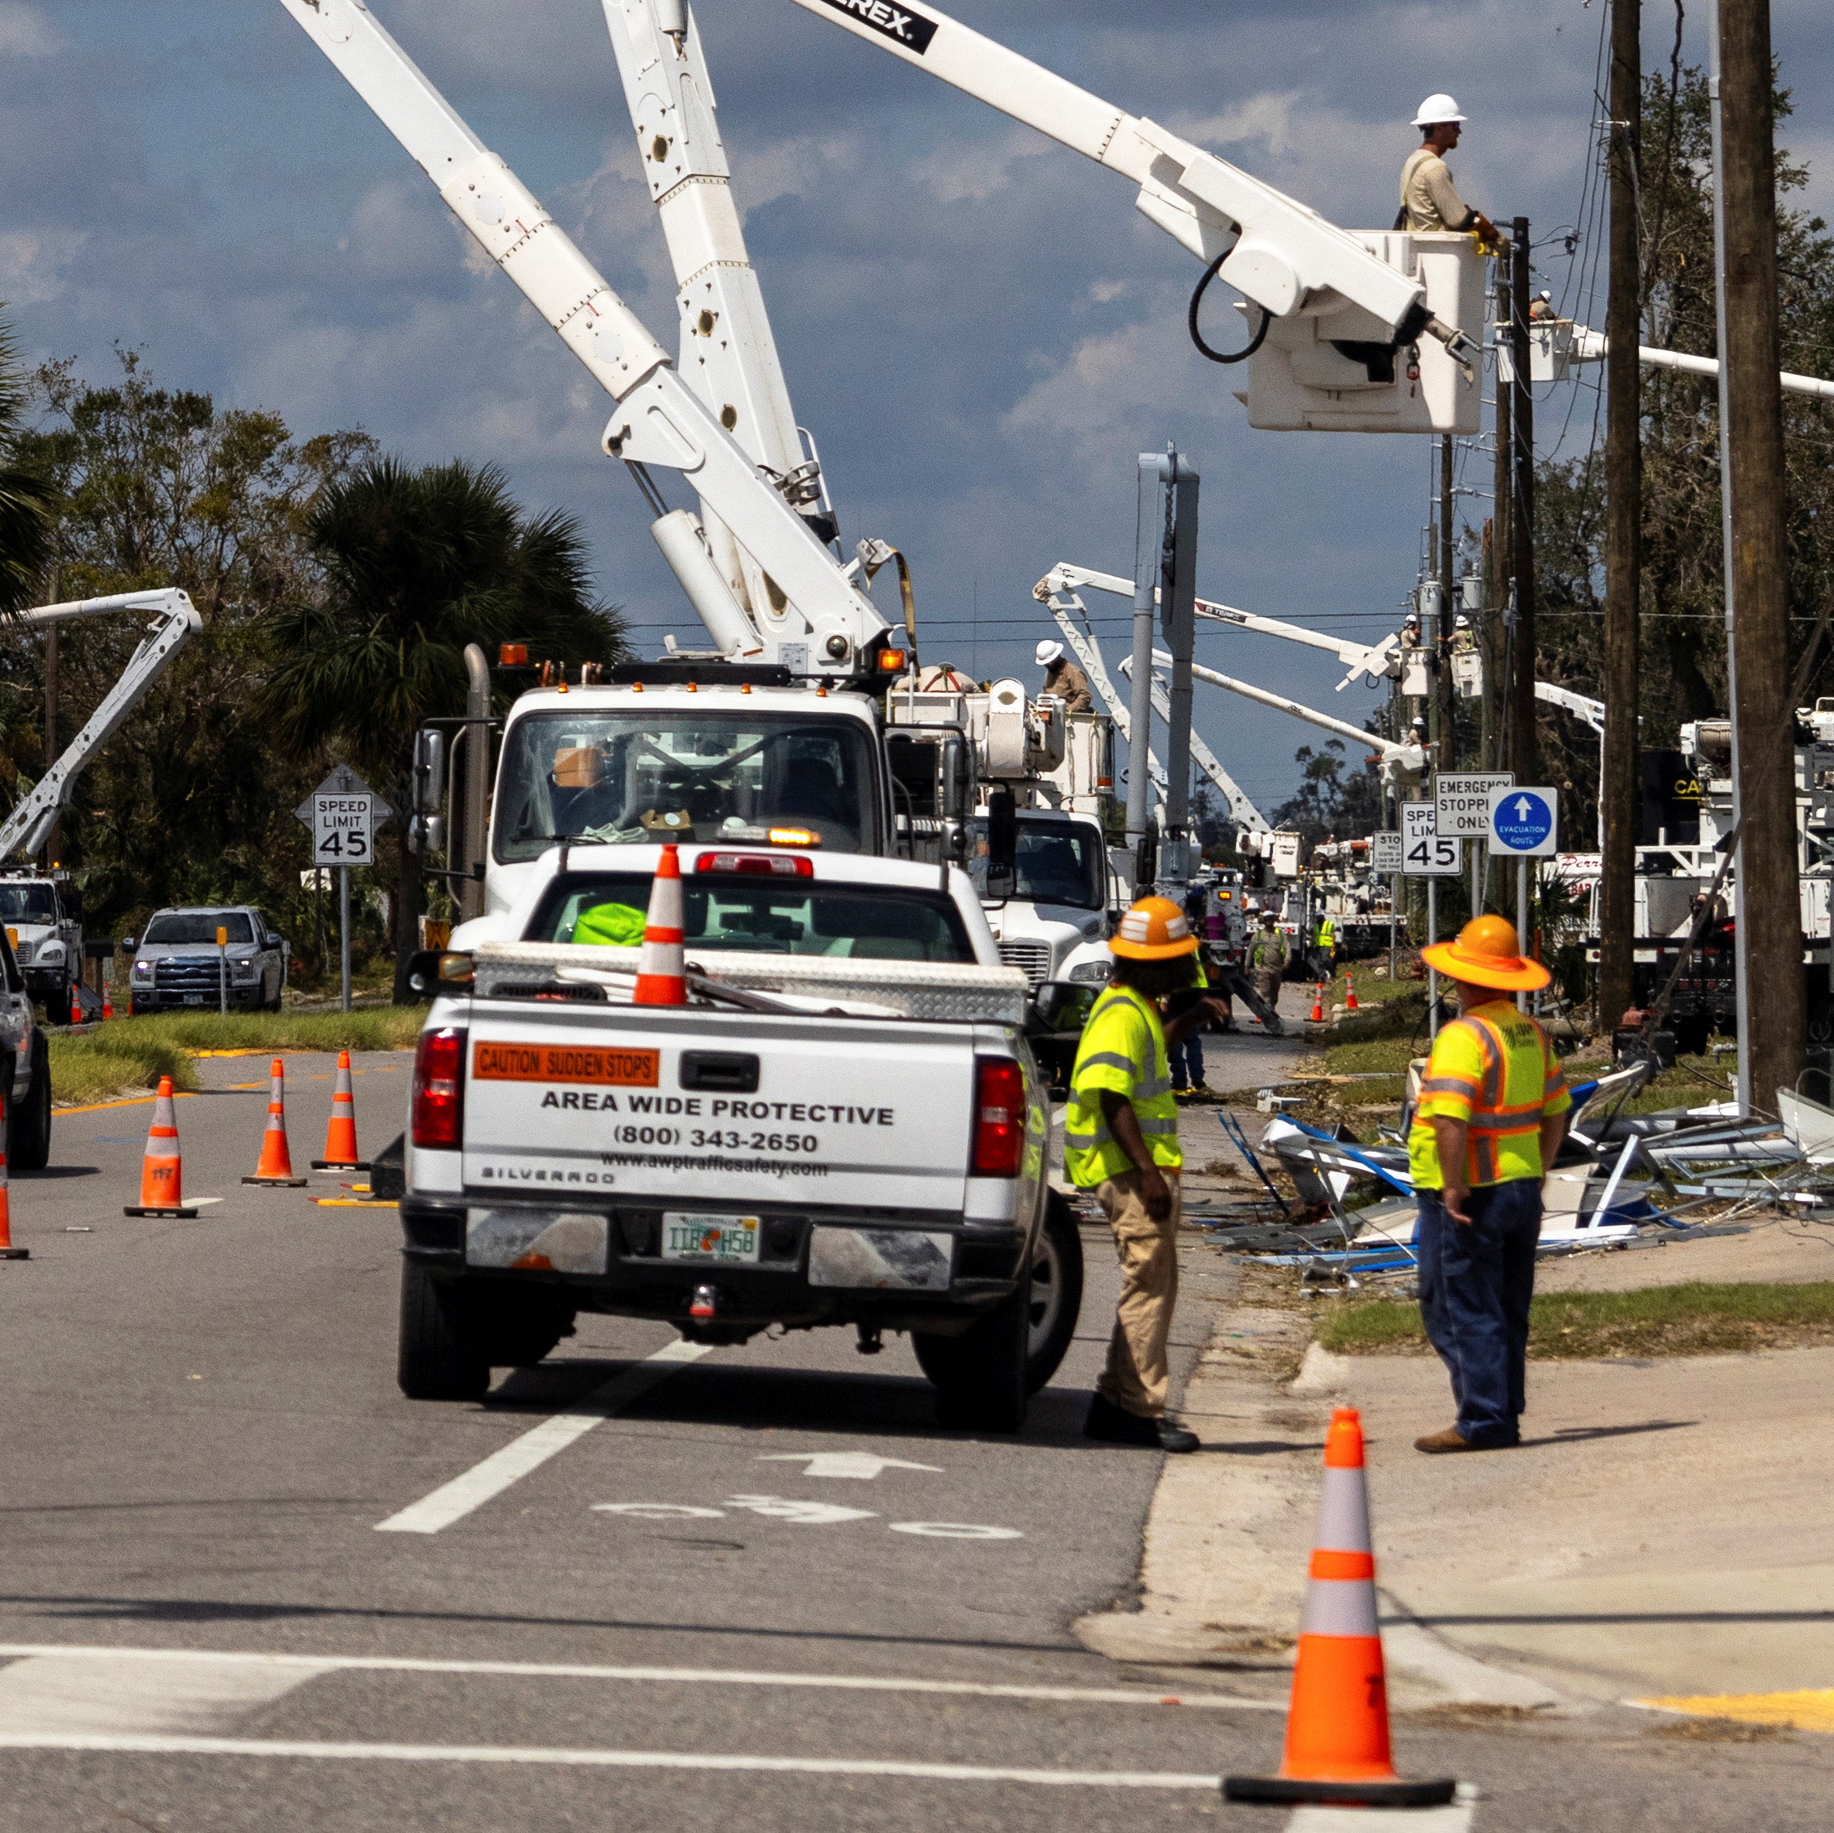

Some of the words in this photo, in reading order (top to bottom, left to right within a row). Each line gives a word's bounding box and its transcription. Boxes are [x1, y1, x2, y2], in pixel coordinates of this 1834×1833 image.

[318, 801, 367, 812] SPEED
[323, 816, 361, 828] LIMIT
[319, 831, 366, 857] 45
[1407, 840, 1455, 866] 45
[480, 1048, 539, 1073] CAUTION
[548, 1051, 602, 1077] SUDDEN
[606, 1054, 650, 1079] STOPS
[541, 1091, 618, 1112] AREA
[628, 1095, 702, 1116] WIDE
[712, 1099, 894, 1126] PROTECTIVE
[614, 1125, 680, 1145] (800)
[690, 1129, 817, 1152] 343-2650
[151, 1168, 173, 1181] 117
[481, 1167, 614, 1184] SILVERADO
[600, 1151, 829, 1180] www.awptrafficsafety.com
